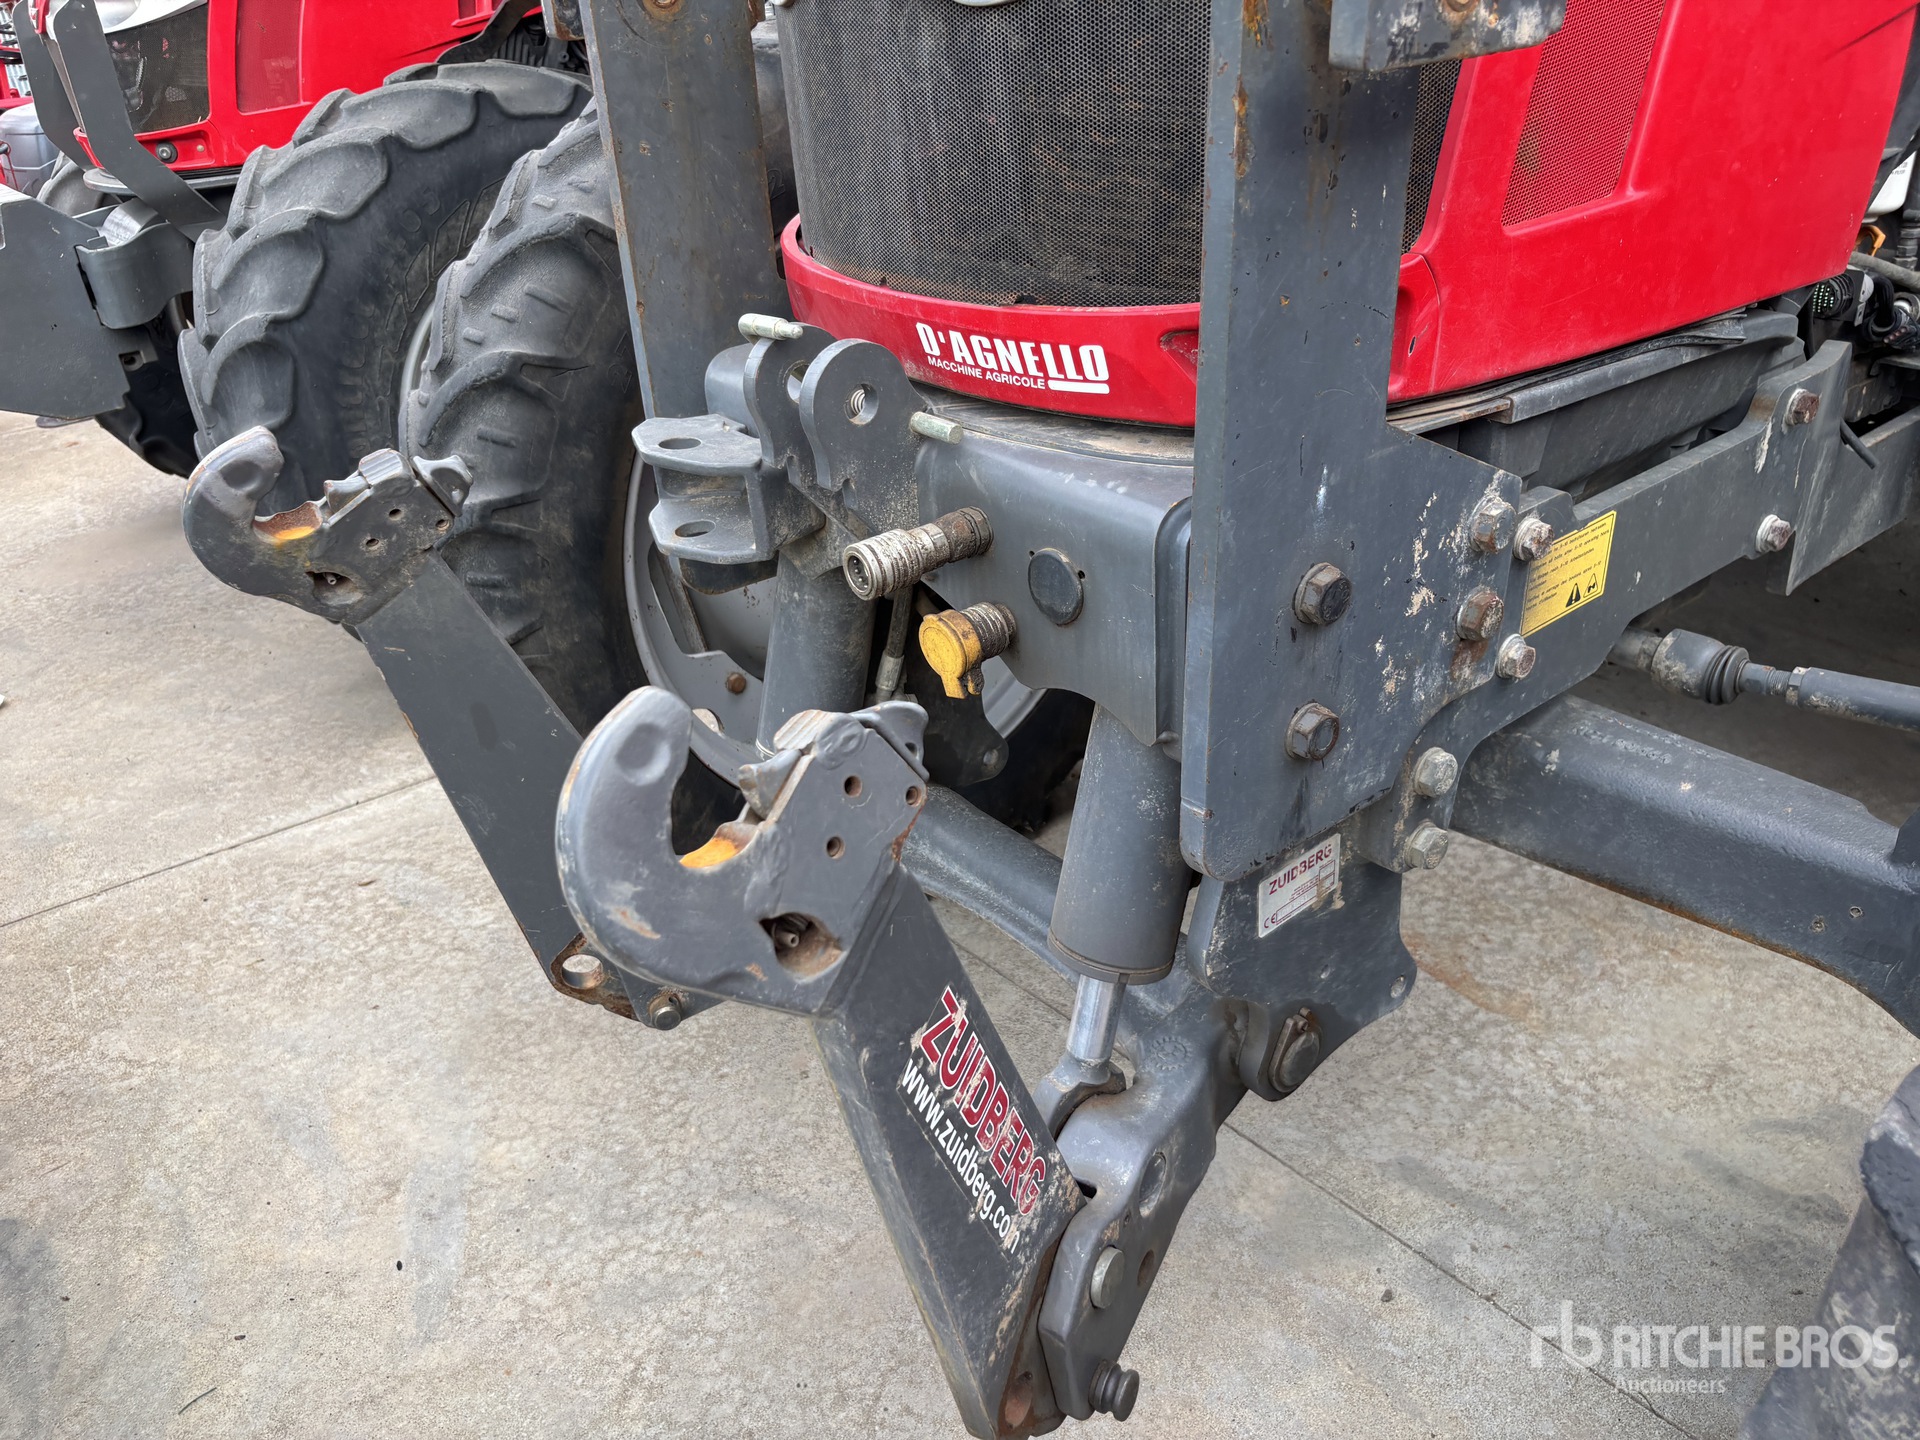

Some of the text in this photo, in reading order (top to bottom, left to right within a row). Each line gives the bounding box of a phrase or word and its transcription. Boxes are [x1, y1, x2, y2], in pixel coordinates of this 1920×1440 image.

[915, 321, 1110, 382] D'AGNELLO
[927, 356, 1046, 390] MACCHINE AGRICOLE
[1269, 843, 1333, 896] ZUIDBERG
[920, 985, 1046, 1216] ZUIDBERG
